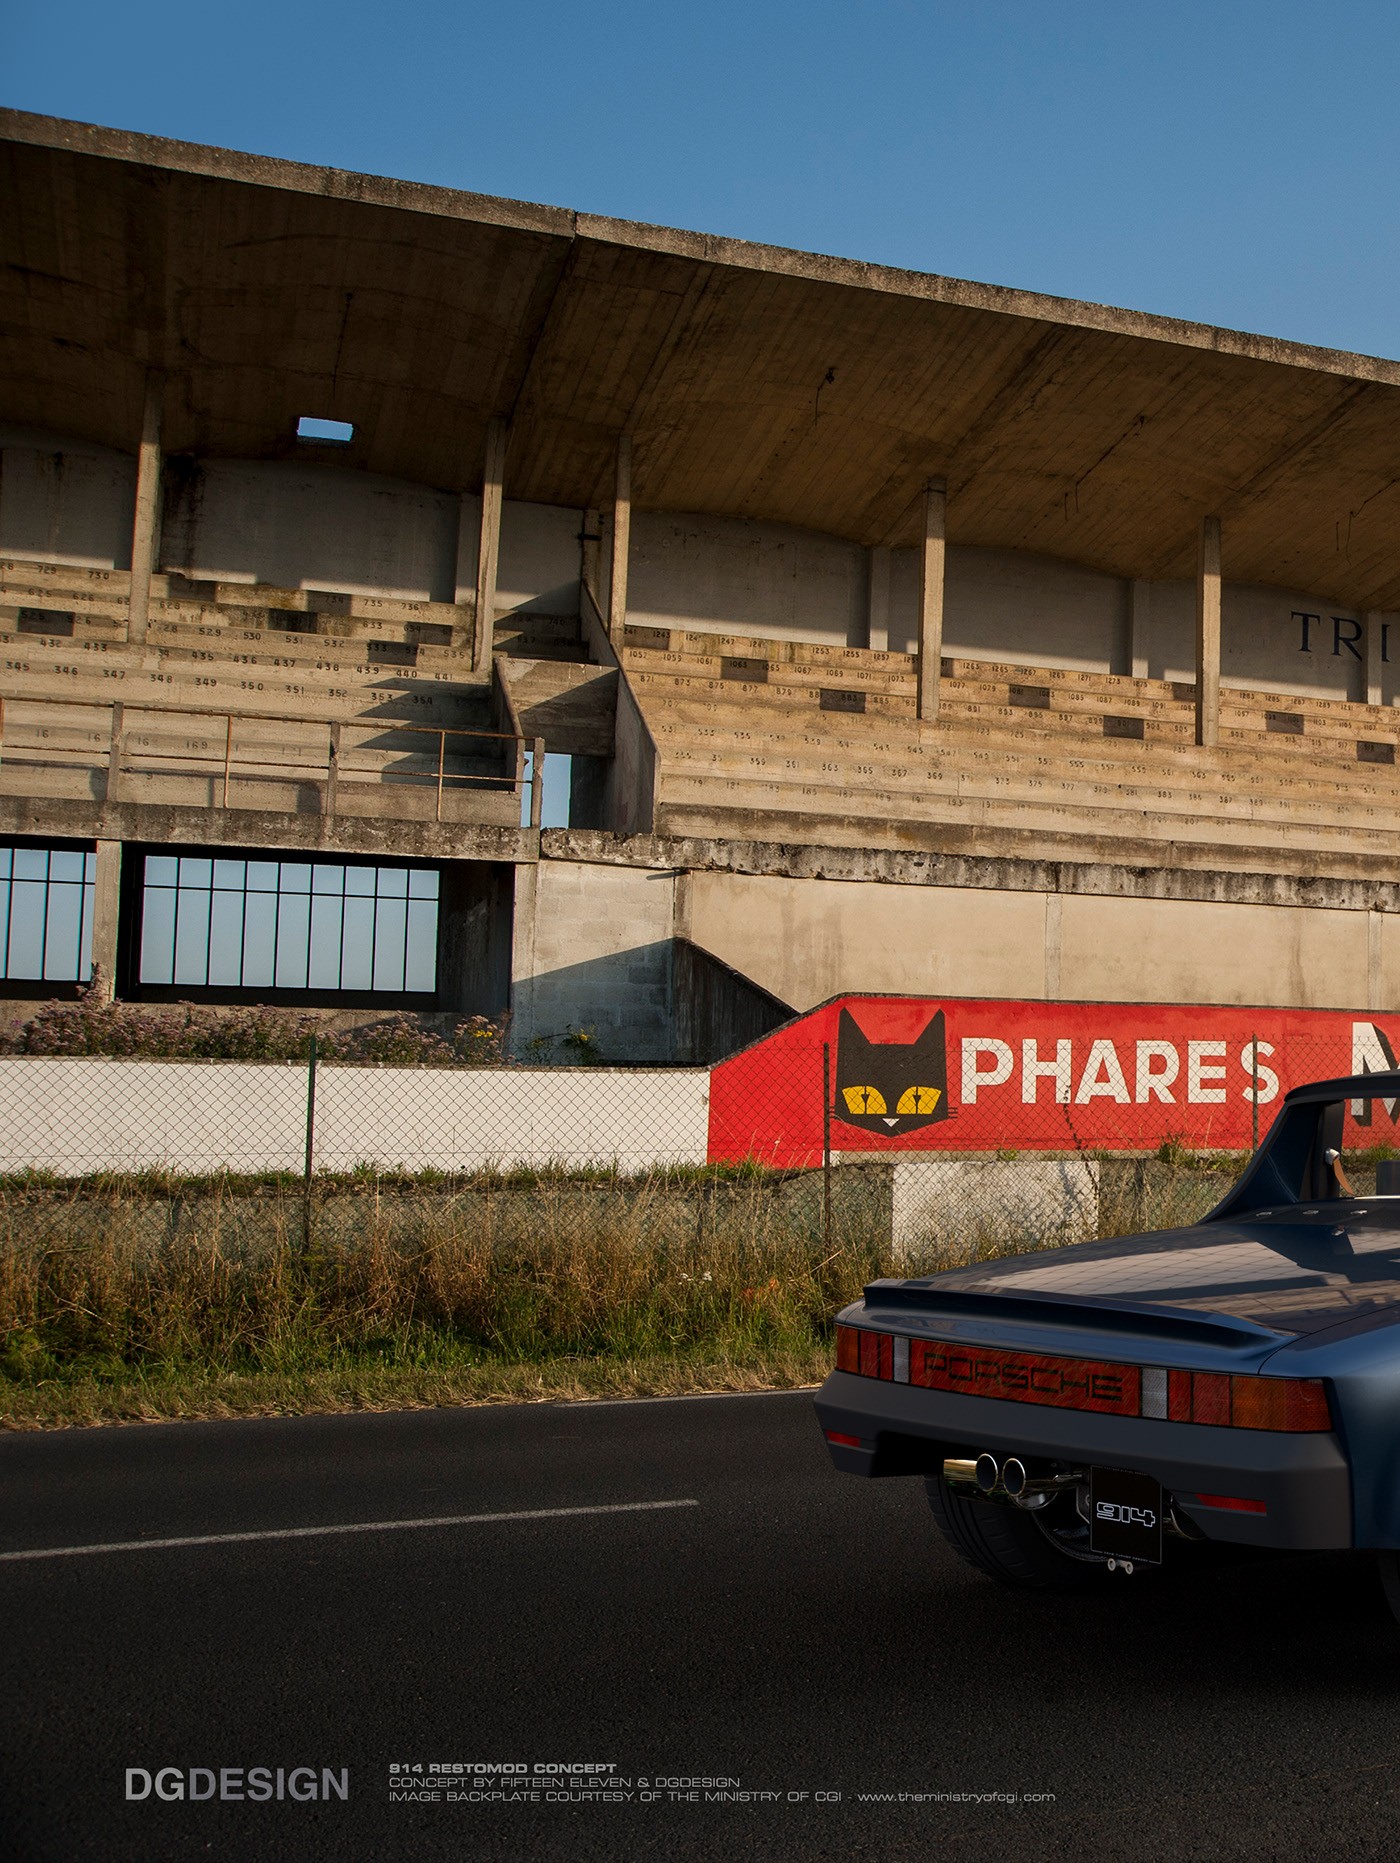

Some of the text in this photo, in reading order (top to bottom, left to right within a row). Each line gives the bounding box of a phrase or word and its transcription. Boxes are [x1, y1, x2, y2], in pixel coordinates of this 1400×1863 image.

[37, 565, 420, 611] 729 730 735 736
[72, 592, 95, 602] 626
[160, 602, 181, 610] 628
[363, 621, 383, 630] 633
[40, 638, 62, 648] 432
[84, 642, 108, 652] 433
[191, 651, 214, 661] 435
[233, 655, 257, 665] 436
[273, 658, 296, 668] 437
[316, 662, 340, 672] 438
[356, 665, 380, 676] 439
[396, 669, 418, 679] 440
[199, 627, 222, 637] 529
[243, 631, 262, 641] 530
[285, 635, 303, 644] 531
[324, 639, 345, 648] 532
[444, 649, 465, 659] 535
[718, 637, 735, 645] 1247
[811, 647, 830, 655] 1253
[842, 650, 860, 659] 1255
[873, 653, 890, 661] 1257
[962, 662, 980, 670] 1263
[1020, 667, 1036, 676] 1267
[1078, 674, 1091, 682] 1271
[5, 661, 30, 672] 345
[53, 665, 79, 676] 346
[103, 670, 126, 680] 347
[150, 674, 173, 684] 348
[195, 678, 217, 687] 349
[240, 681, 264, 691] 350
[285, 685, 304, 695] 351
[328, 688, 348, 698] 352
[371, 692, 394, 701] 353
[640, 675, 655, 683] 871
[674, 678, 691, 686] 873
[708, 681, 724, 690] 875
[776, 688, 792, 696] 879
[663, 653, 682, 662] 1059
[696, 657, 713, 665] 1061
[794, 666, 811, 675] 1067
[826, 669, 844, 677] 1069
[857, 671, 872, 680] 1071
[888, 674, 905, 683] 1073
[950, 681, 965, 689] 1077
[979, 684, 996, 692] 1079
[186, 740, 208, 750] 169
[750, 757, 766, 766] 359
[821, 763, 839, 772] 363
[857, 766, 873, 775] 365
[927, 772, 943, 781] 369
[1028, 780, 1043, 788] 375
[1061, 783, 1075, 791] 377
[961, 1037, 1279, 1105] PHARES
[924, 1351, 1124, 1402] PORSCHE
[1096, 1501, 1156, 1528] 914
